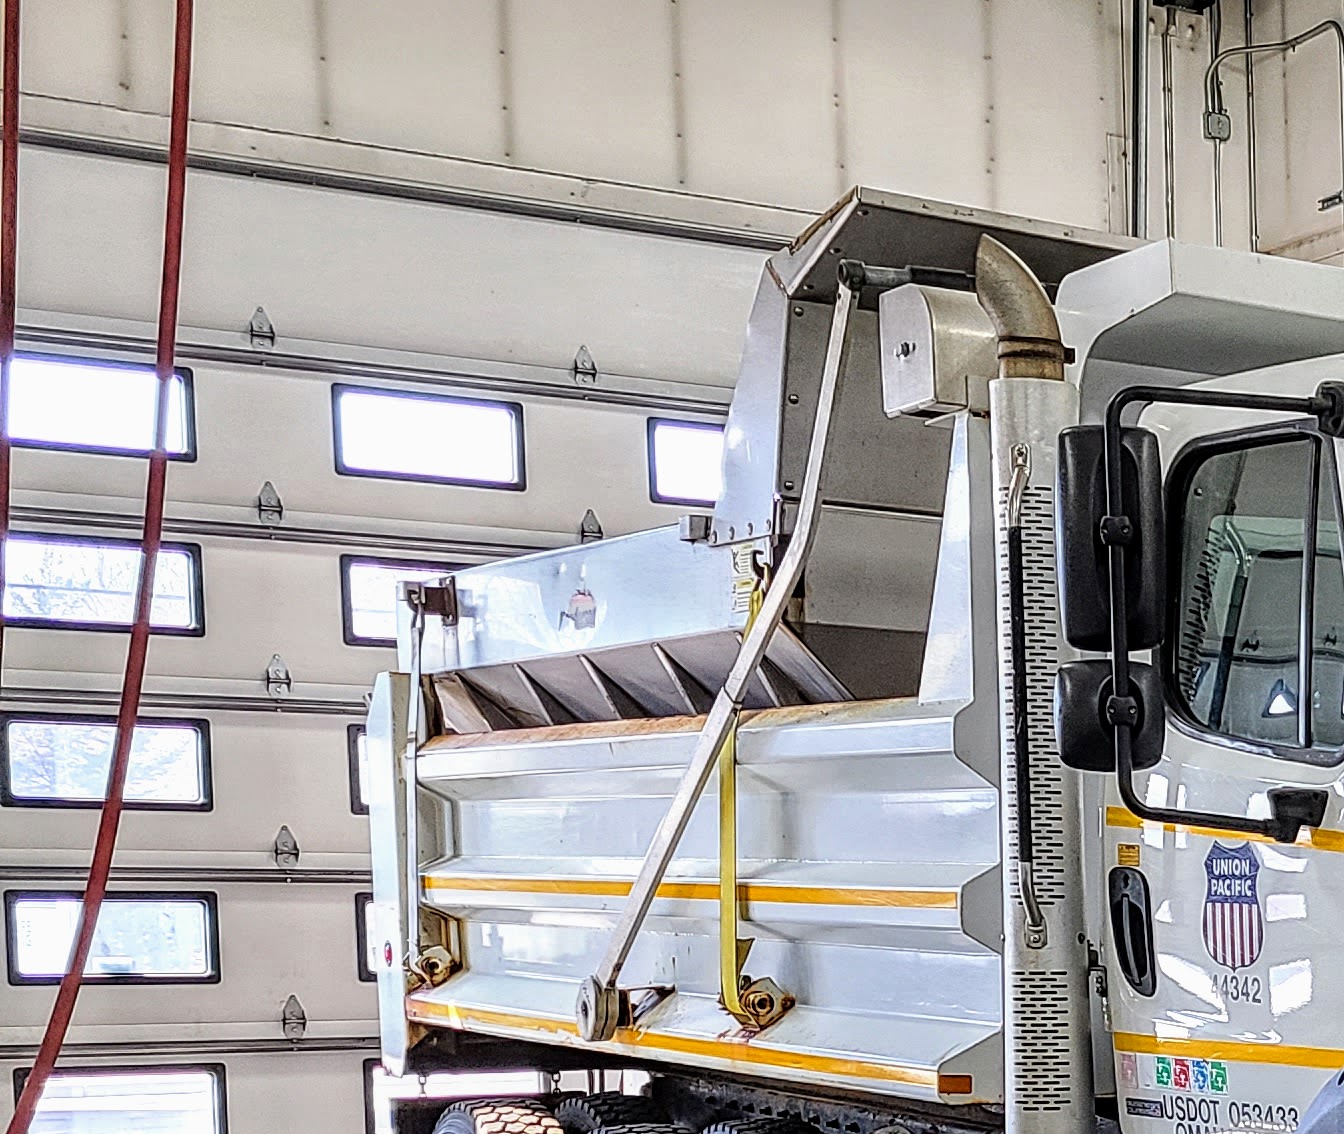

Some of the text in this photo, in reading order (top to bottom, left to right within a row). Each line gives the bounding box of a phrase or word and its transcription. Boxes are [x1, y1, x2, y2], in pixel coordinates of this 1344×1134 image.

[1212, 858, 1250, 876] UNION
[1210, 877, 1252, 897] PACIFIC
[1211, 974, 1262, 1004] 44342
[1162, 1094, 1220, 1126] USDOT
